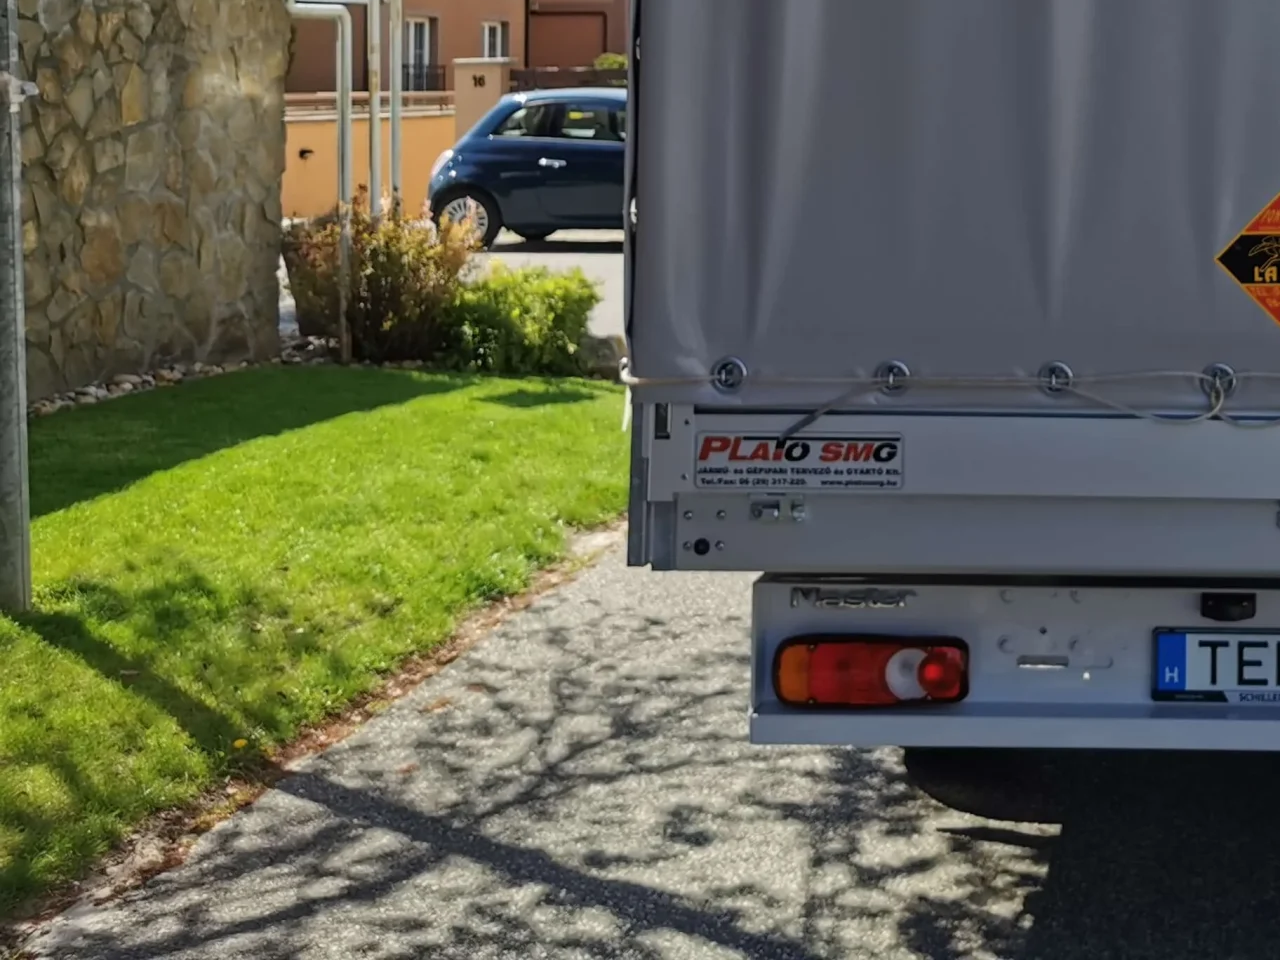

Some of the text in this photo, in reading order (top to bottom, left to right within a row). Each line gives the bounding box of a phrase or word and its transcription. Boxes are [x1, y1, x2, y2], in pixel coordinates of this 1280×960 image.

[472, 74, 486, 88] 16
[818, 441, 899, 462] SMG
[1164, 666, 1179, 683] H
